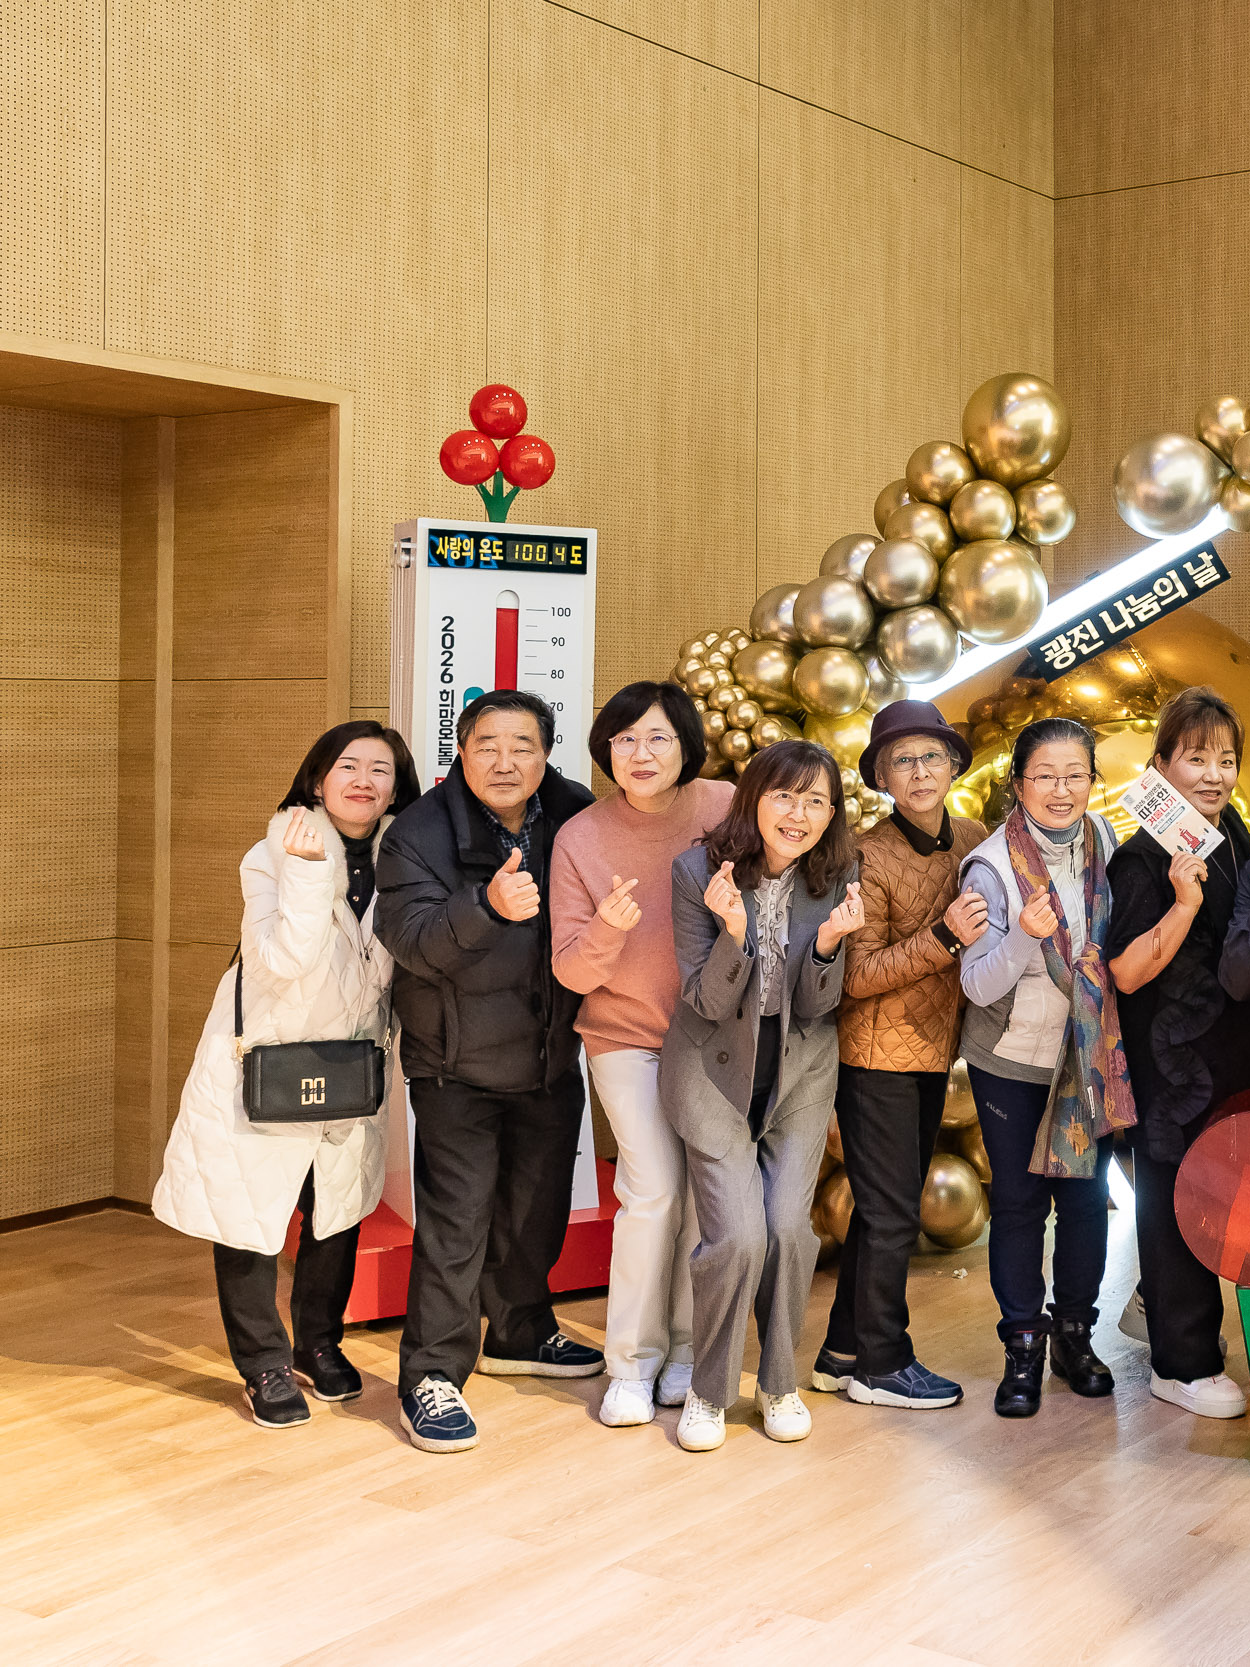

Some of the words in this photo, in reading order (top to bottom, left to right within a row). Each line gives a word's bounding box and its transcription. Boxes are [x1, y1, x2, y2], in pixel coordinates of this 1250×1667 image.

[436, 536, 475, 561] 사랑의
[479, 538, 504, 561] 온도
[570, 545, 583, 565] 도
[551, 607, 571, 617] 100
[1040, 618, 1104, 670] 광진
[1099, 569, 1188, 634] 나눔의
[1183, 551, 1221, 588] 날
[551, 637, 565, 647] 90
[550, 669, 565, 679] 80
[550, 702, 564, 712] 70
[1138, 788, 1171, 820] 따뜻한
